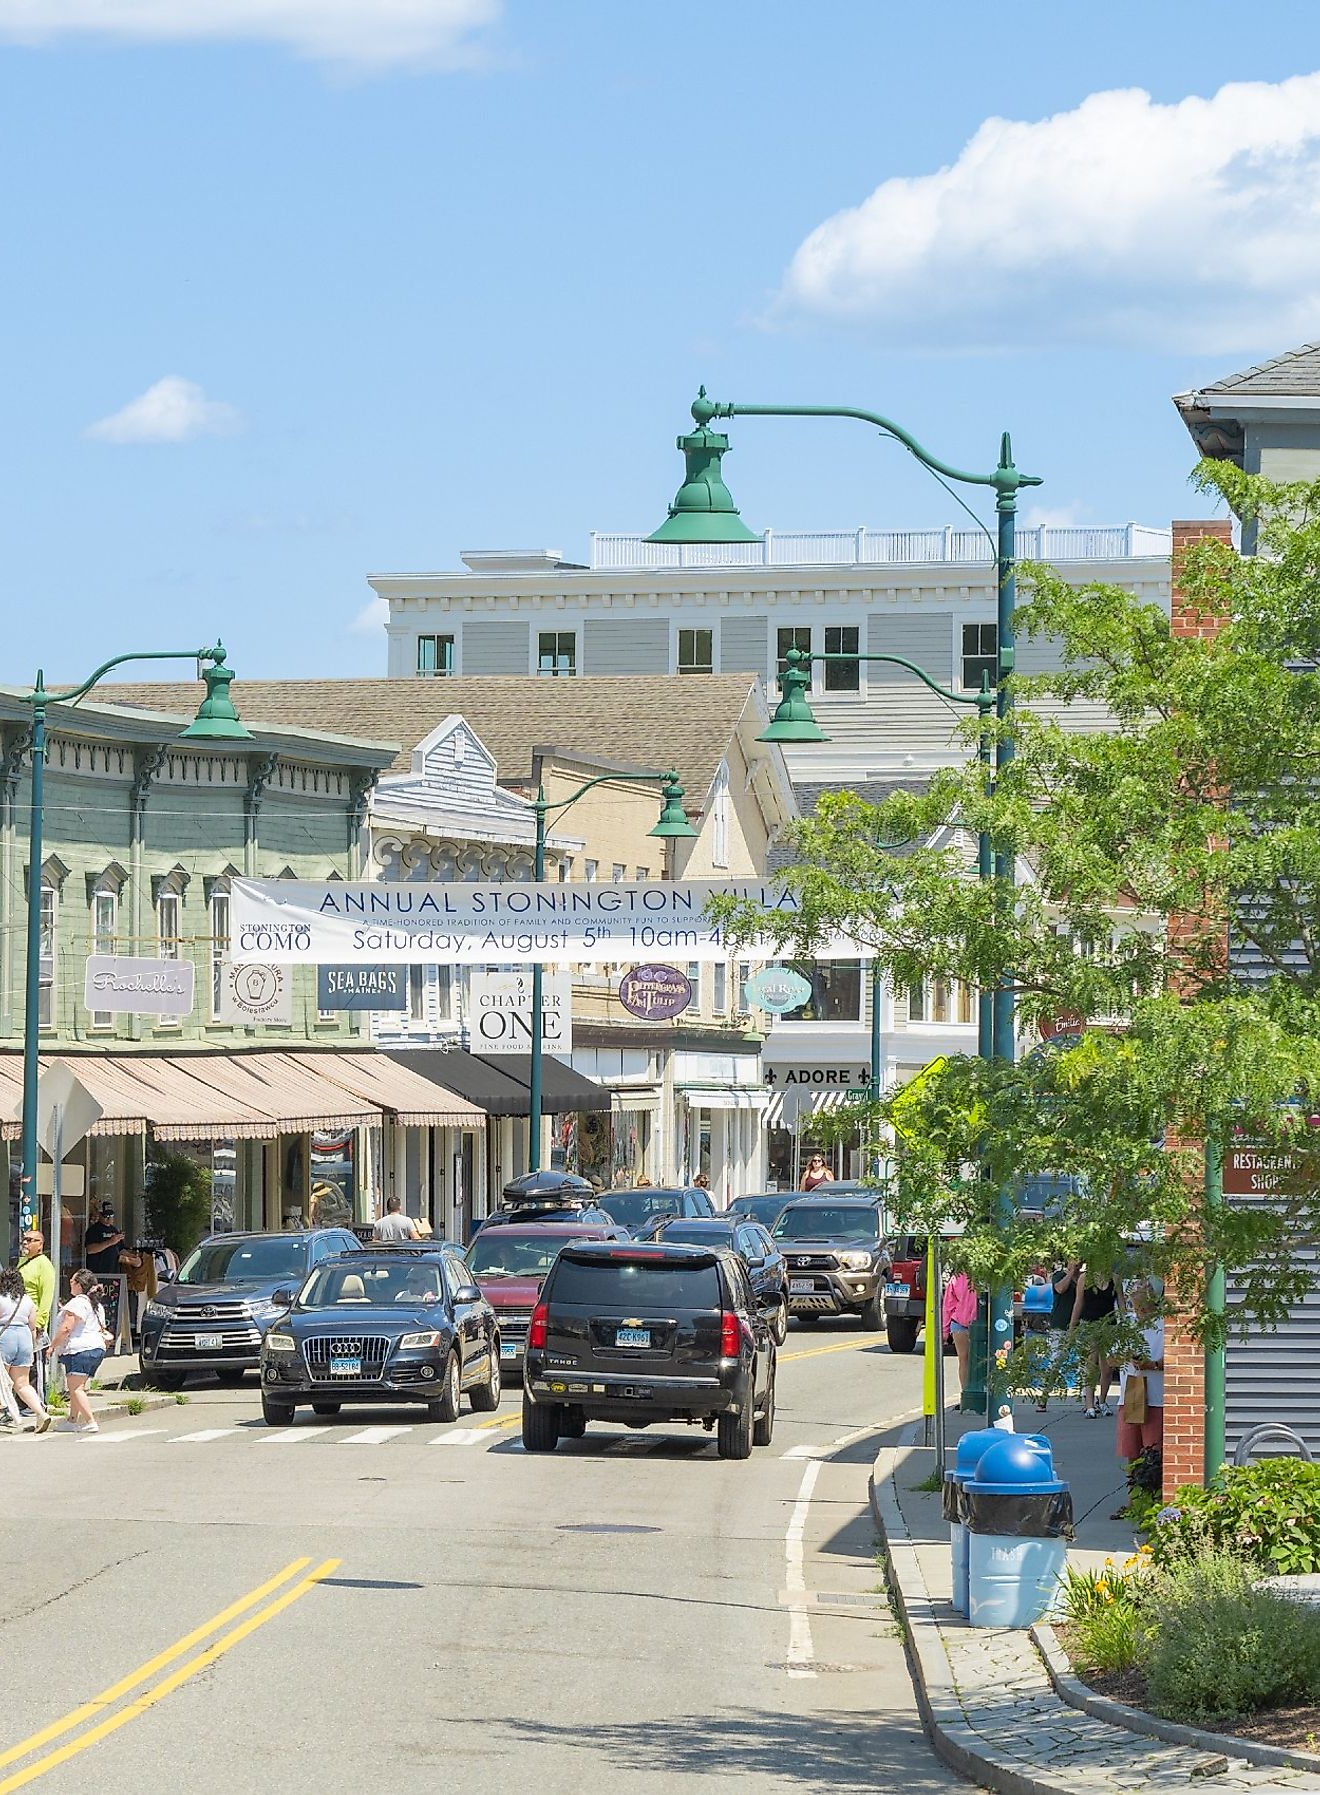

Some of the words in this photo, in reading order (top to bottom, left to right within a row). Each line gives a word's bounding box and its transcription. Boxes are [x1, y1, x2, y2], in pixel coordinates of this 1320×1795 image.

[319, 892, 457, 913] ANNUAL
[472, 890, 692, 914] STONINGTON
[239, 923, 312, 933] STONINGTON
[371, 918, 444, 927] TIME-HONORED
[446, 918, 496, 926] TRADITION
[498, 918, 512, 926] OF
[514, 918, 547, 926] FAMILY
[574, 917, 632, 926] COMMUNITY
[635, 916, 653, 925] FUN
[657, 916, 669, 924] TO
[672, 915, 711, 924] SUPPOR
[239, 932, 312, 951] COMO
[352, 929, 473, 954] Saturday,
[480, 930, 569, 953] August
[582, 925, 611, 948] 5th
[92, 972, 185, 995] Rochelle's
[328, 971, 354, 993] SEA
[358, 971, 397, 994] BAGS
[479, 994, 561, 1007] CHAPER
[479, 1010, 562, 1040] ONE
[784, 1069, 851, 1084] ADORE
[549, 1358, 578, 1366] TAHOE
